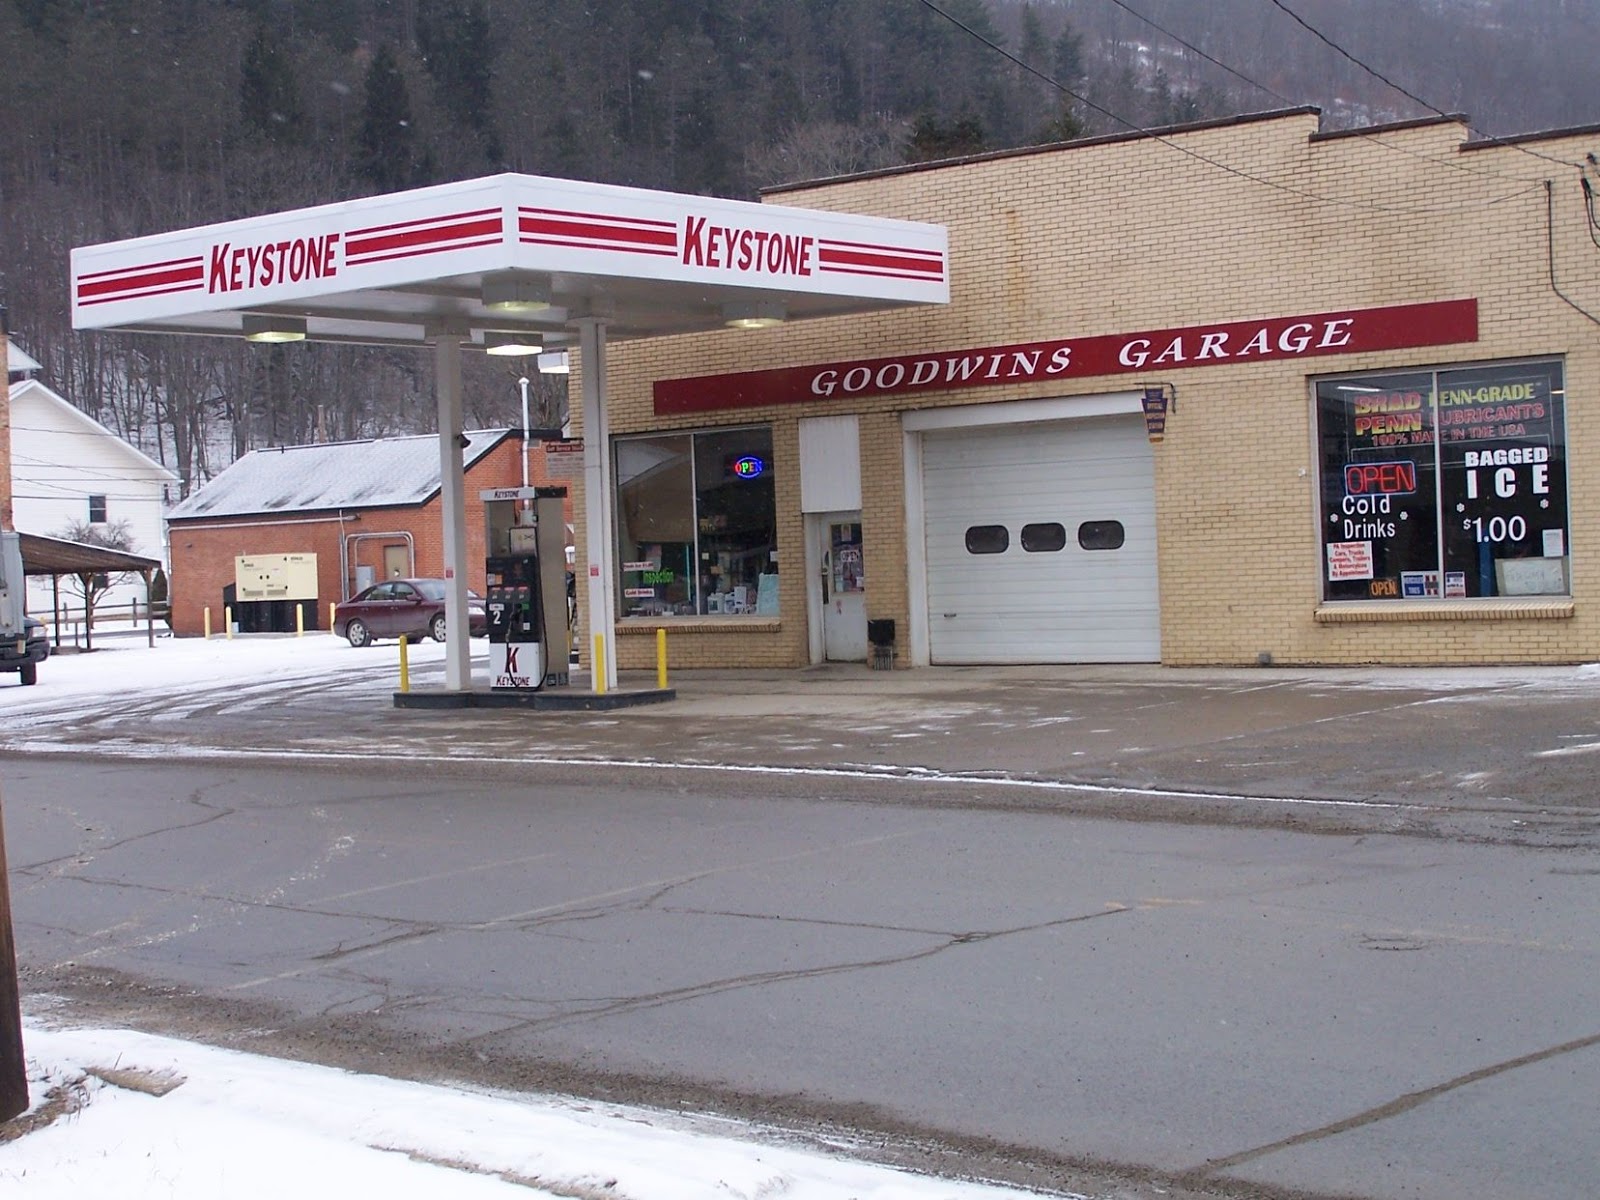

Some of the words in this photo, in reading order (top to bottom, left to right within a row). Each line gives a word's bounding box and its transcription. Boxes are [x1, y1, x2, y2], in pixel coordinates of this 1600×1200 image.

[682, 215, 814, 277] KEYSTONE
[208, 233, 340, 295] KEYSTONE
[810, 346, 1072, 398] GOODWINS
[1118, 317, 1355, 369] GARAGE
[1354, 391, 1422, 414] BRAD
[1355, 412, 1422, 436] PENN
[1371, 433, 1408, 447] 100%
[1411, 430, 1449, 444] MAE
[1451, 429, 1465, 440] IN
[1469, 427, 1495, 439] THE
[1500, 423, 1526, 436] USA
[735, 461, 762, 474] OPEN
[1464, 447, 1549, 467] BAGGED
[1346, 463, 1414, 494] OPEN
[1466, 464, 1550, 499] ICE
[494, 490, 520, 499] KEYSTONE
[1342, 494, 1391, 515] Cold
[1344, 518, 1396, 540] Drinks
[1463, 515, 1527, 543] $1.00
[841, 551, 858, 562] OPEN
[1371, 580, 1397, 596] OPEN
[493, 610, 501, 625] 2
[504, 646, 520, 673] K
